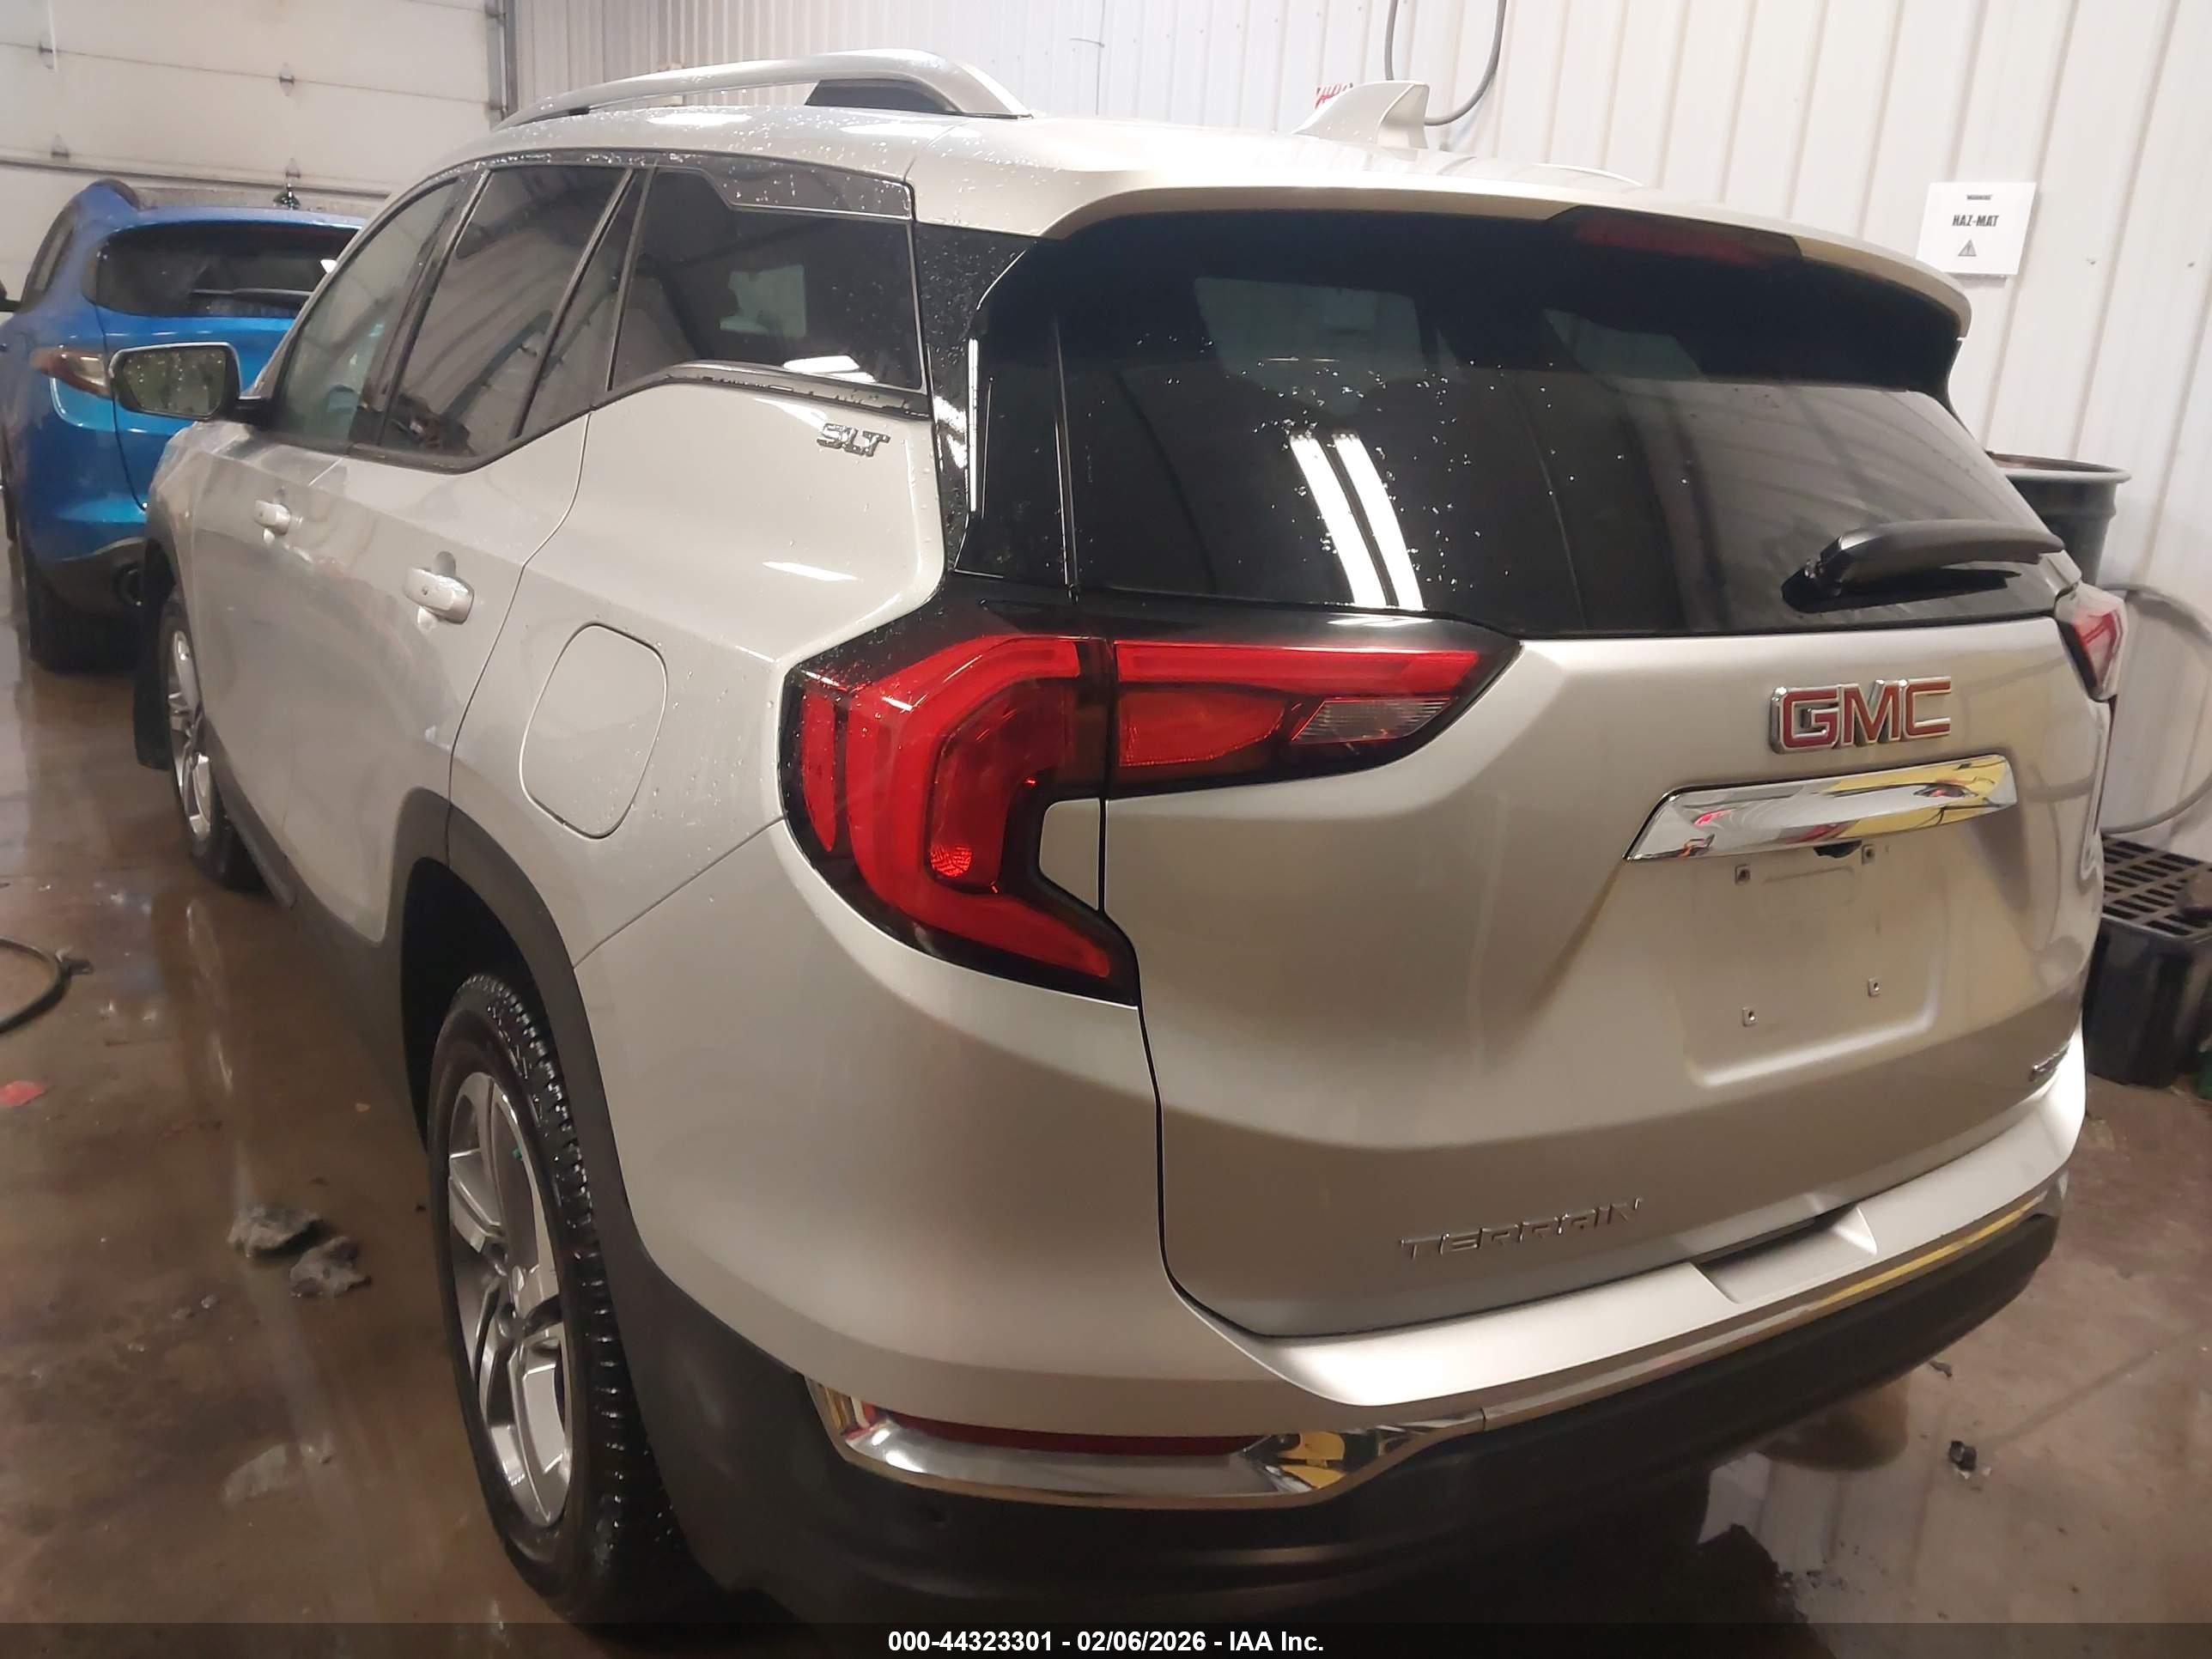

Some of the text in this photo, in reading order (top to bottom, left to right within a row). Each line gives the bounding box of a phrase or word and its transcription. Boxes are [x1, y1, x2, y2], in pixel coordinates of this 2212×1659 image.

[1952, 215, 1999, 227] HAZ-MAT
[817, 422, 890, 457] SLT
[1769, 677, 1951, 755] GMC
[1399, 1197, 1644, 1260] TERRAIN
